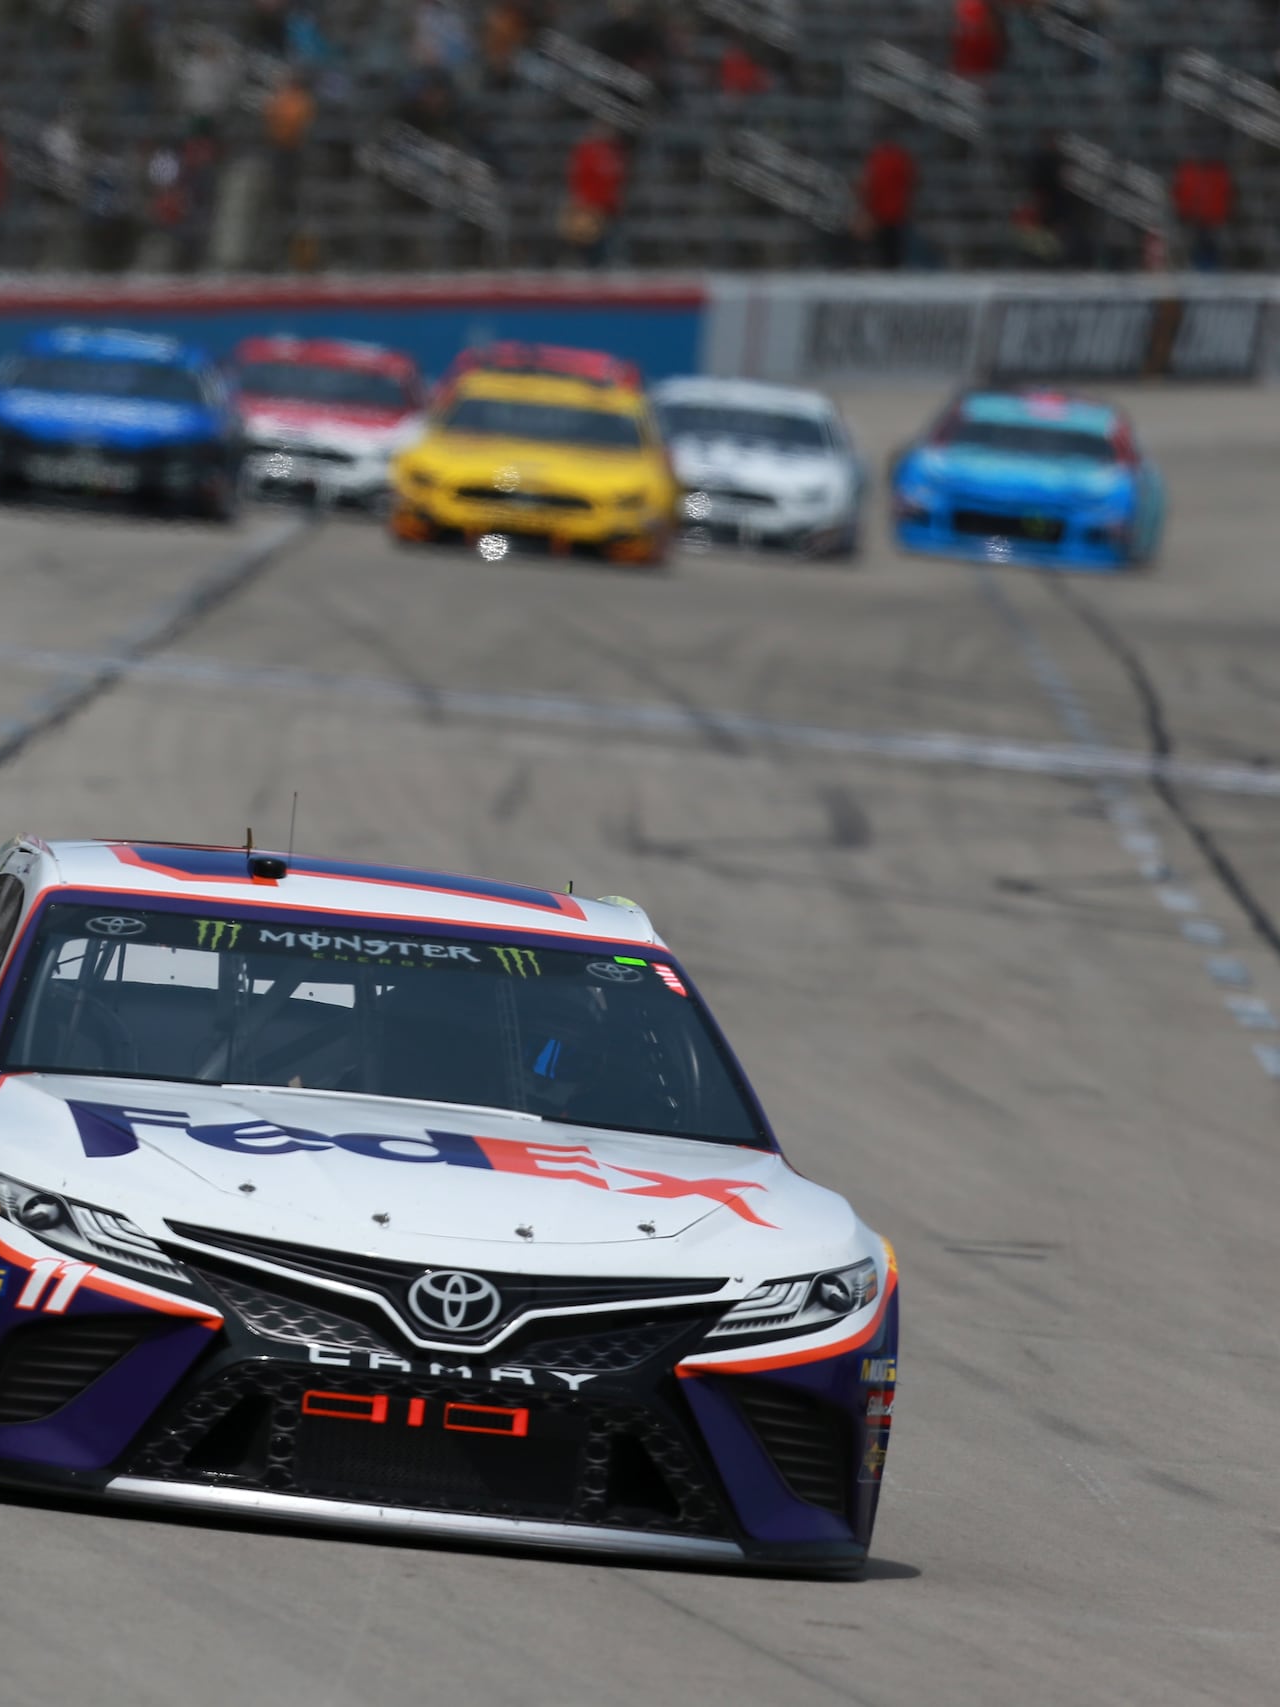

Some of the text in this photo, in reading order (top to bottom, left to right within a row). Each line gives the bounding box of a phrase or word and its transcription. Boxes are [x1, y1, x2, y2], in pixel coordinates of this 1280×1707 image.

[259, 930, 481, 962] MONSTER
[15, 1257, 98, 1315] 11
[307, 1342, 599, 1391] CAMRY
